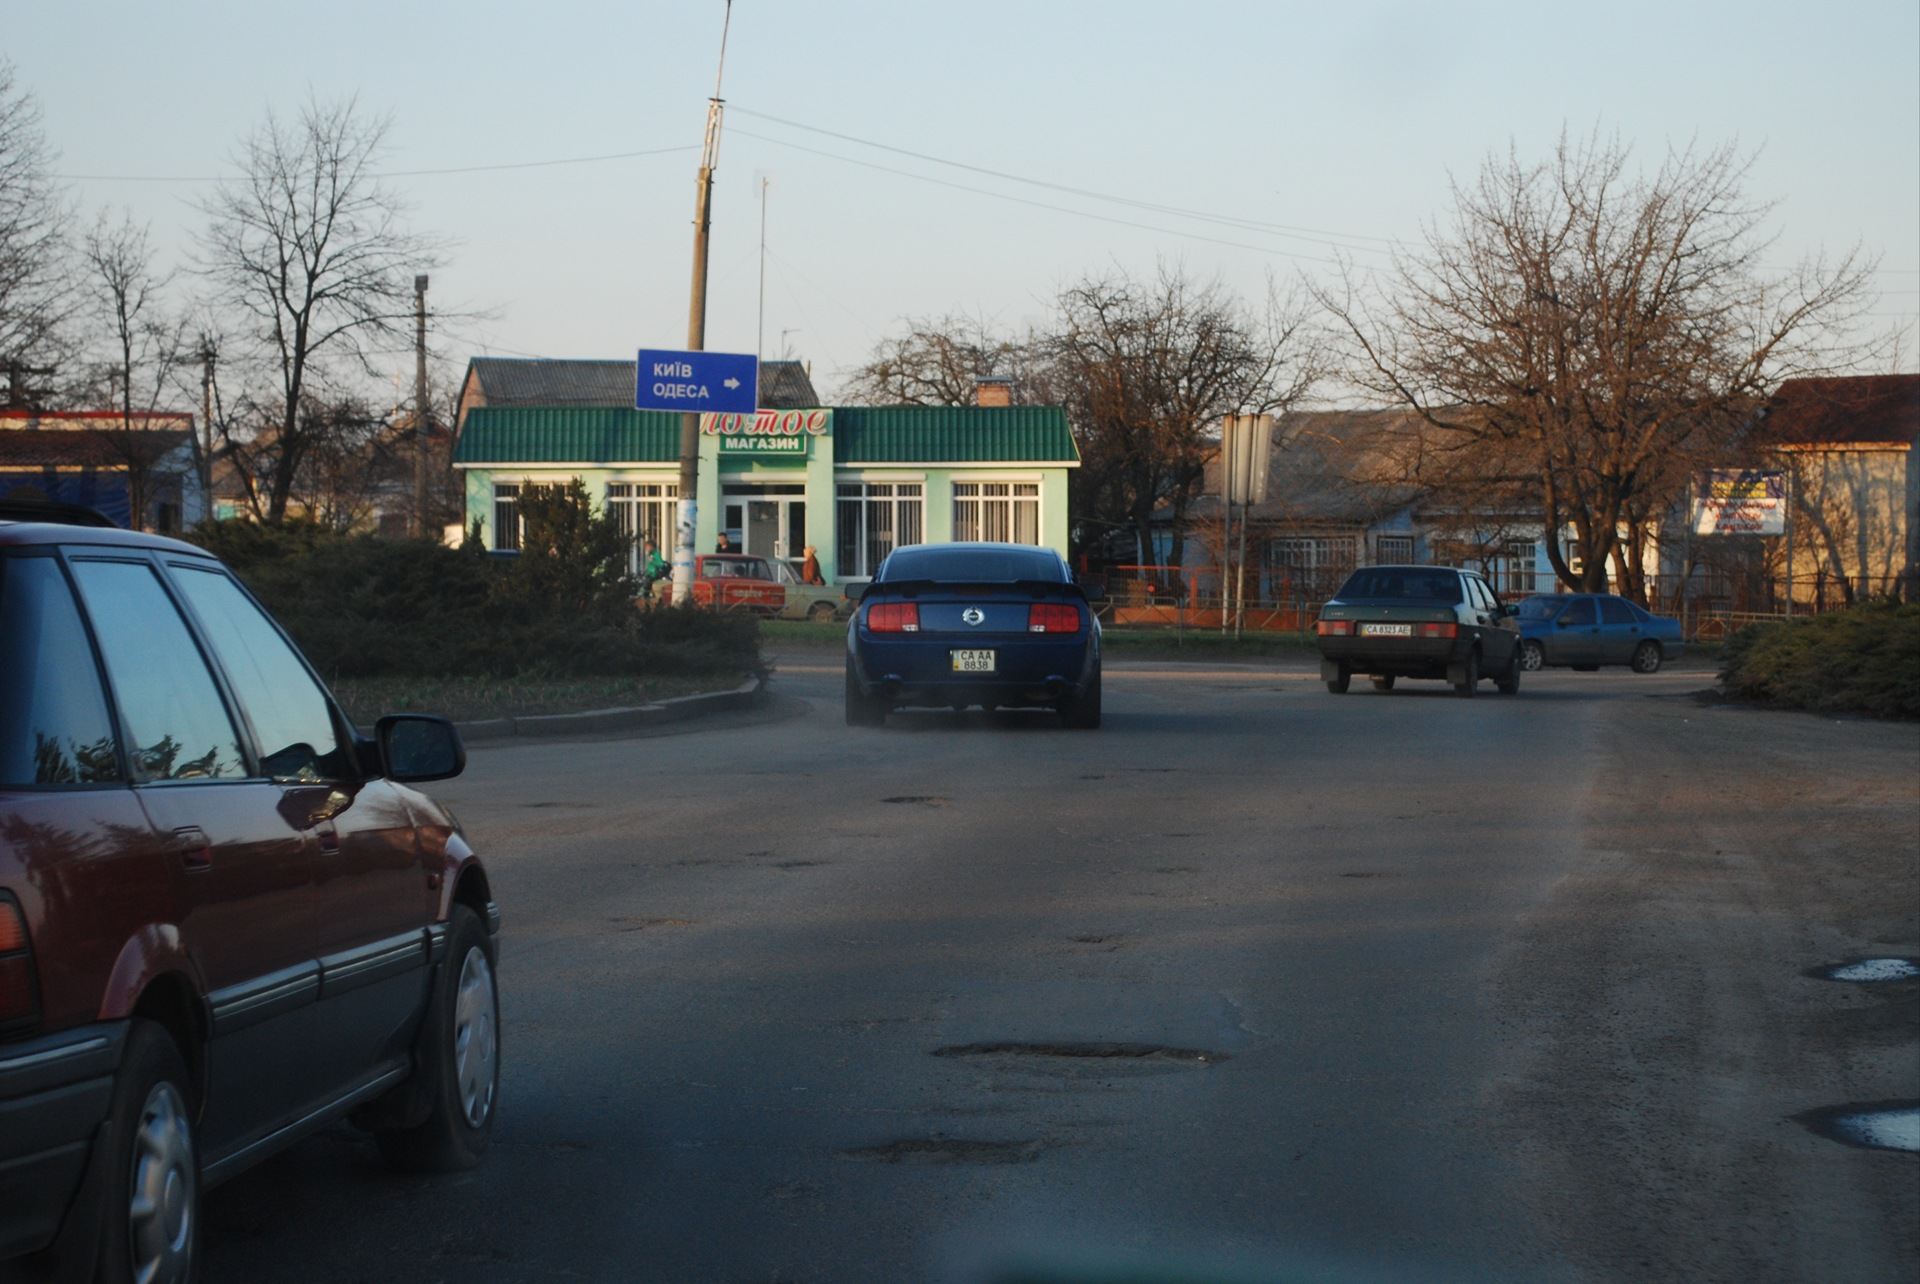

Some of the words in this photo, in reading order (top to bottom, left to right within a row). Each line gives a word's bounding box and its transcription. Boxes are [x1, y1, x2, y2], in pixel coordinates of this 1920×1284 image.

[653, 362, 692, 378] КИЇВ
[653, 383, 709, 399] ОДЕСА
[725, 437, 799, 450] МАГАЗИН
[961, 651, 975, 660] CA
[978, 651, 992, 660] AA
[964, 661, 988, 670] 8838
